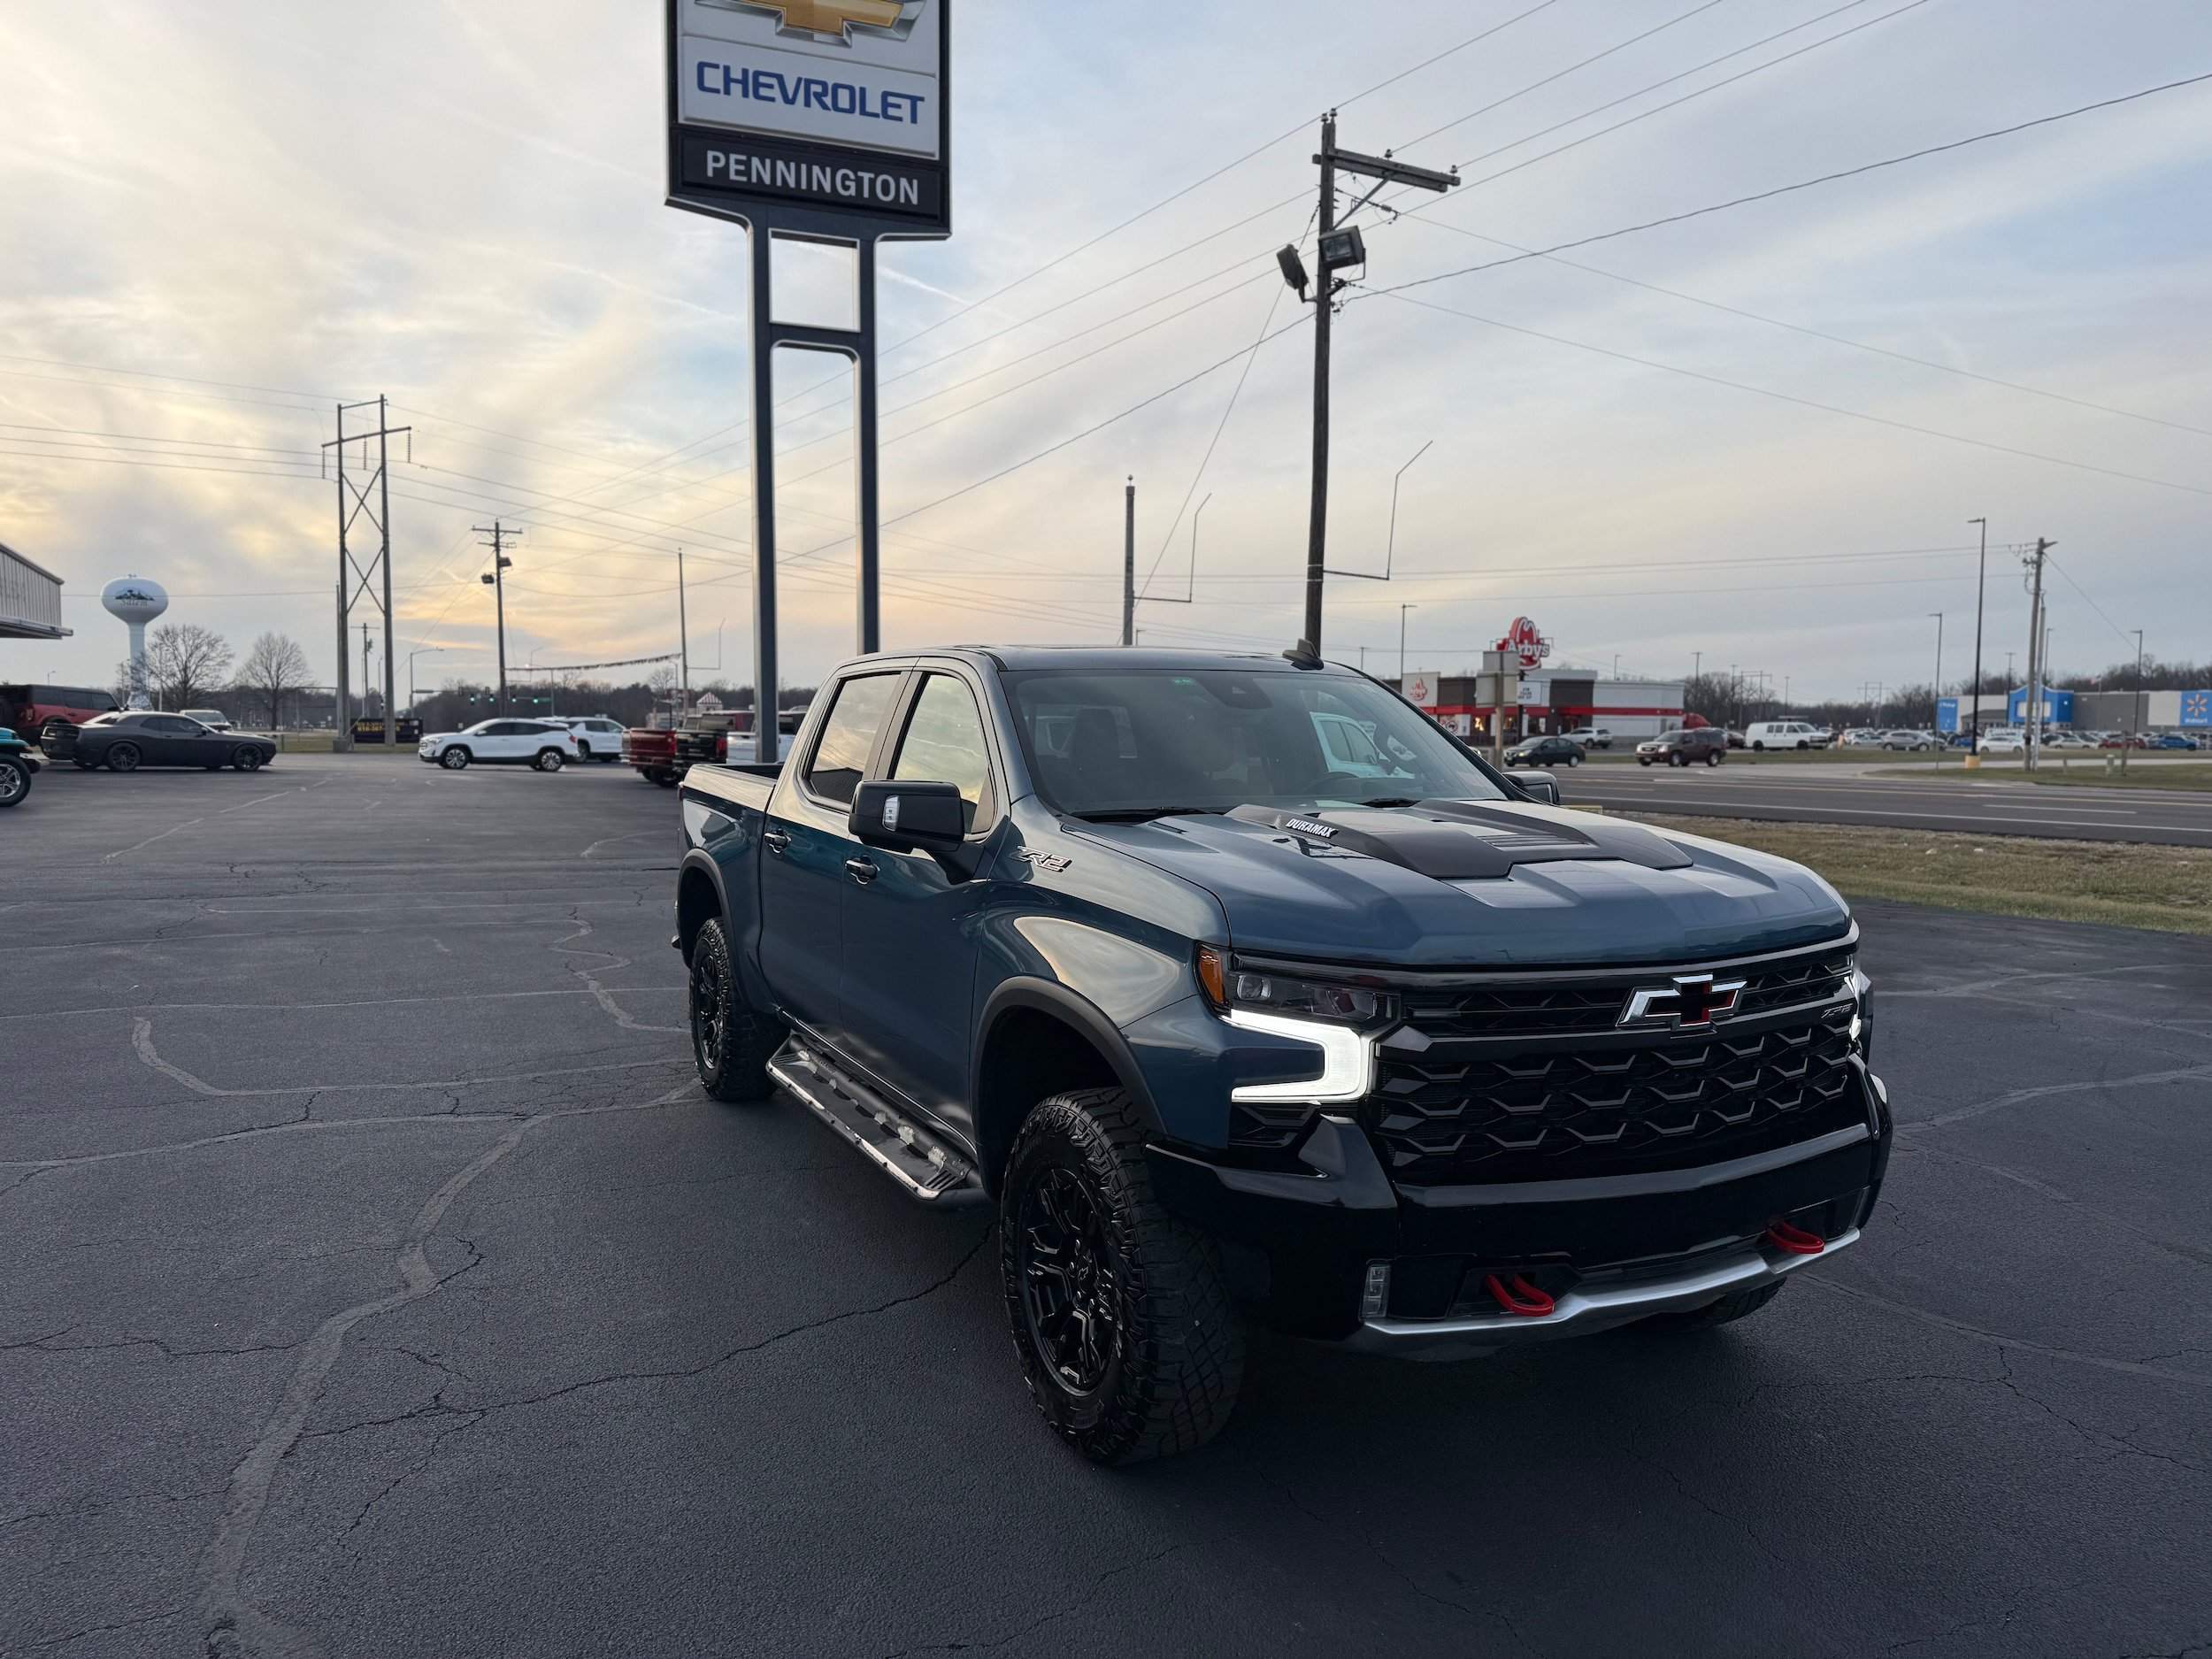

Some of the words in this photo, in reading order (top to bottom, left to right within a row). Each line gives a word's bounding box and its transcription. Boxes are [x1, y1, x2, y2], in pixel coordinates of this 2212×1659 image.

[697, 61, 926, 125] CHEVROLET
[706, 150, 919, 205] PENNINGTON
[1286, 818, 1338, 839] DURAMAX
[1008, 845, 1072, 873] ZR2
